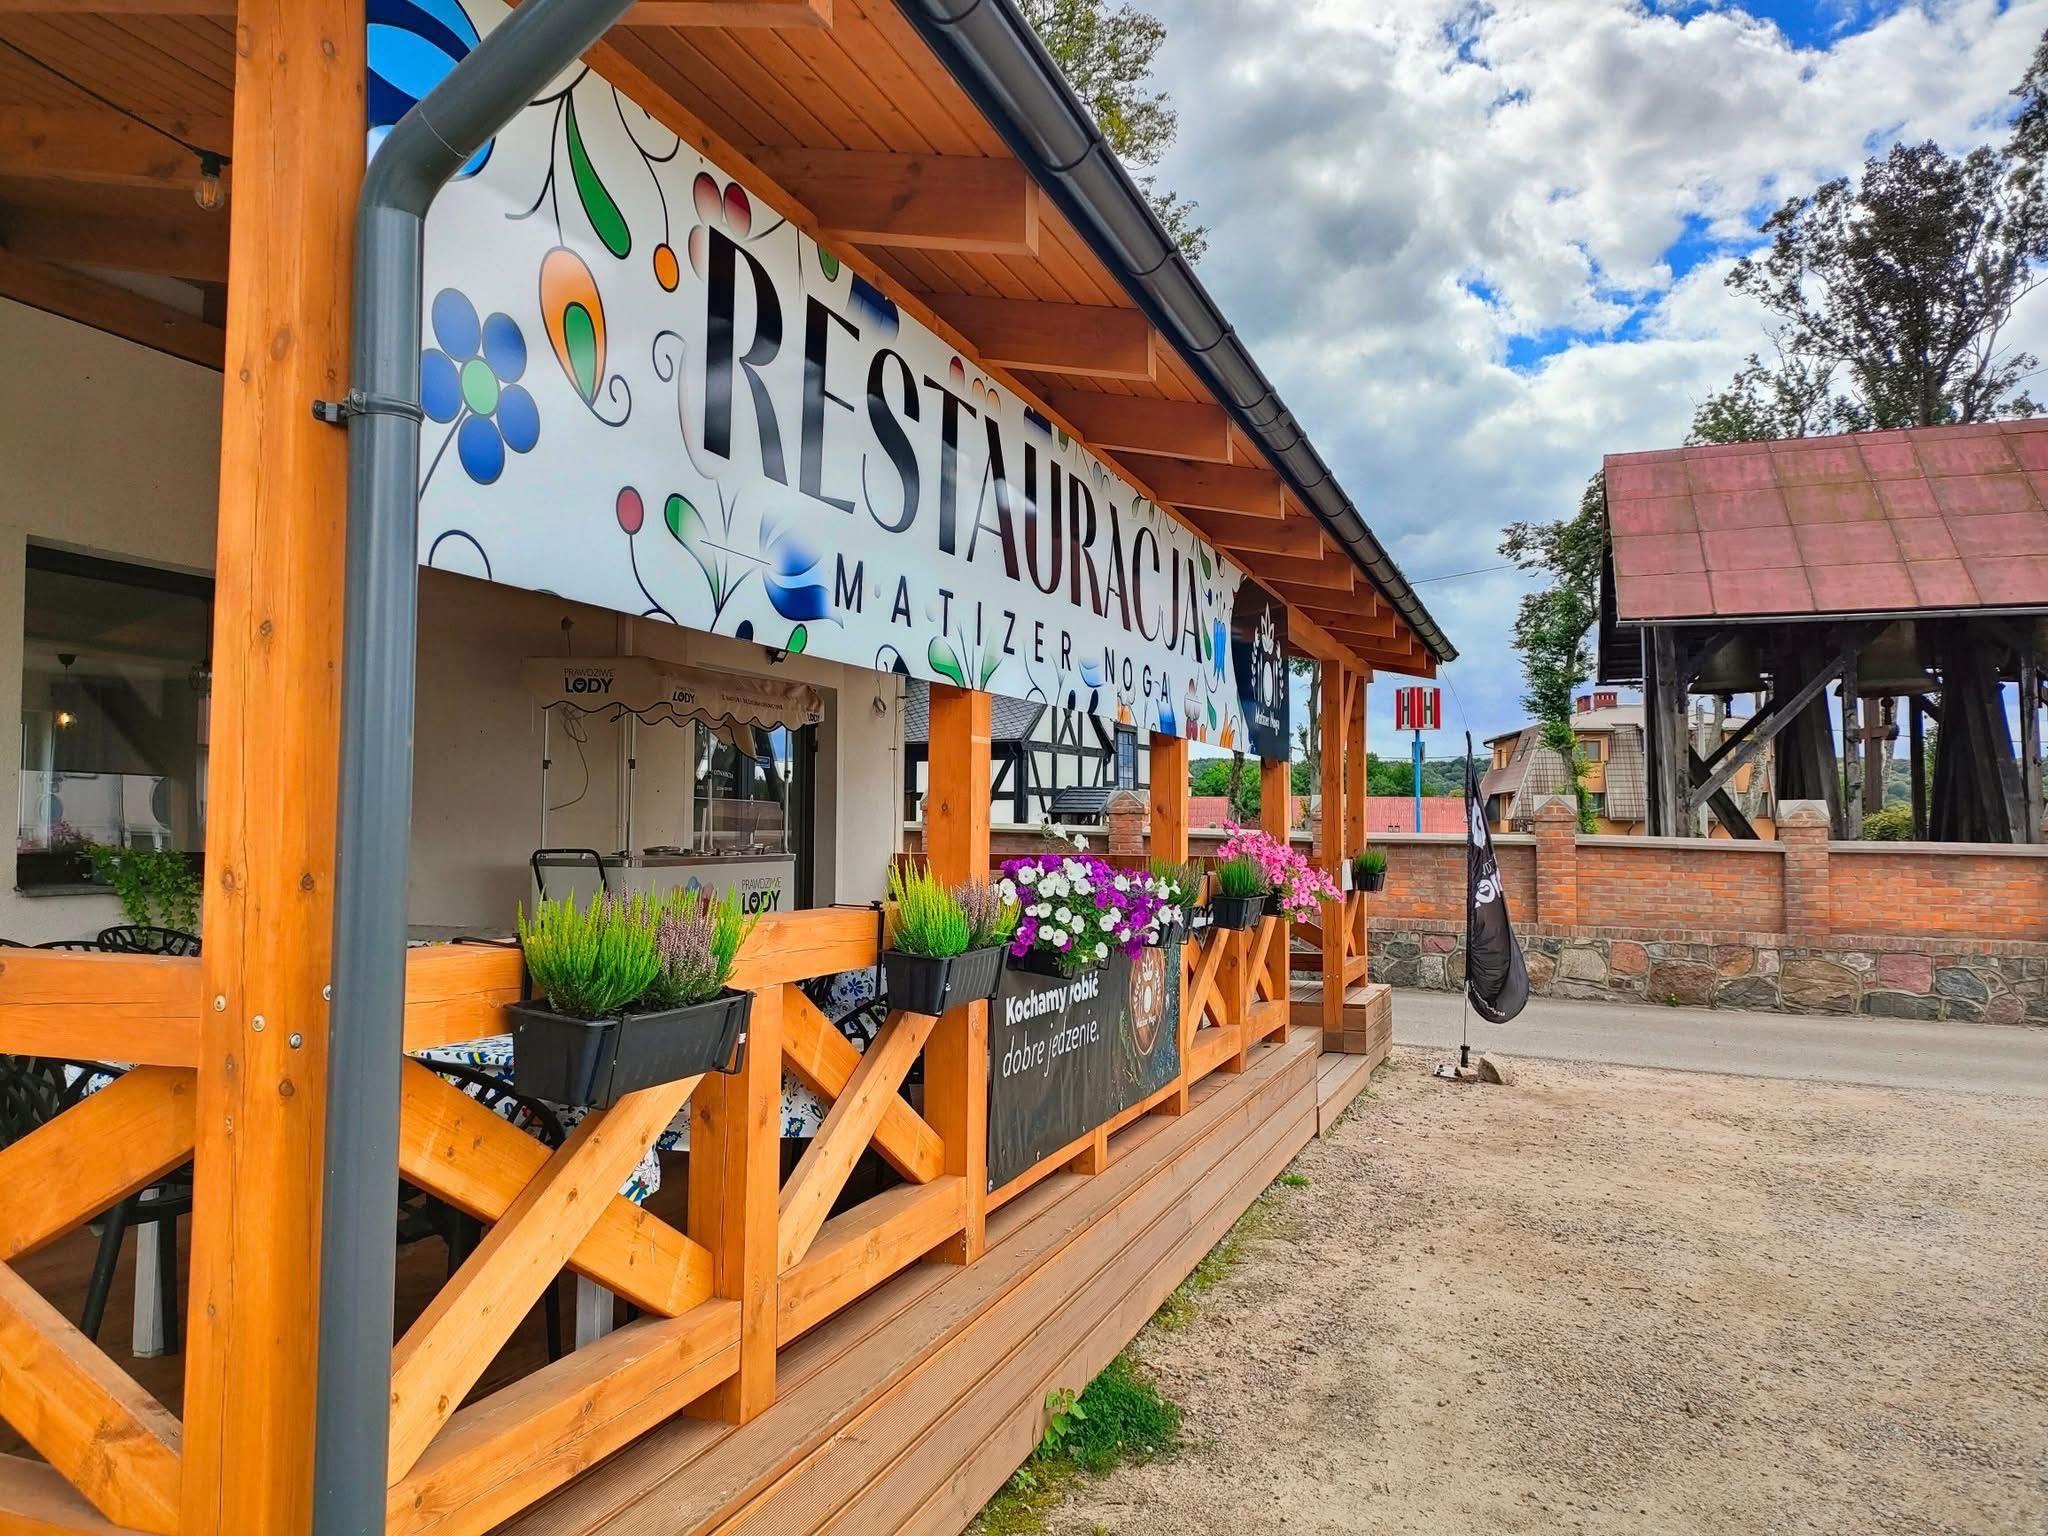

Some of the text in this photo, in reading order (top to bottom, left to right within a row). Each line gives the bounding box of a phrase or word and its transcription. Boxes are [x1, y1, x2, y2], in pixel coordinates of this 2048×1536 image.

[704, 225, 1202, 664] RESTAURACJA
[834, 552, 1169, 703] MATIZER NOGA
[564, 668, 615, 677] PRAWDZIWE
[564, 677, 614, 693] LODY
[672, 690, 695, 704] LODY
[741, 876, 782, 890] PRAWDZIWE
[741, 890, 781, 915] LODY
[1005, 970, 1099, 1027] Kochamy robić
[1002, 1009, 1100, 1078] dobre jedzenie.
